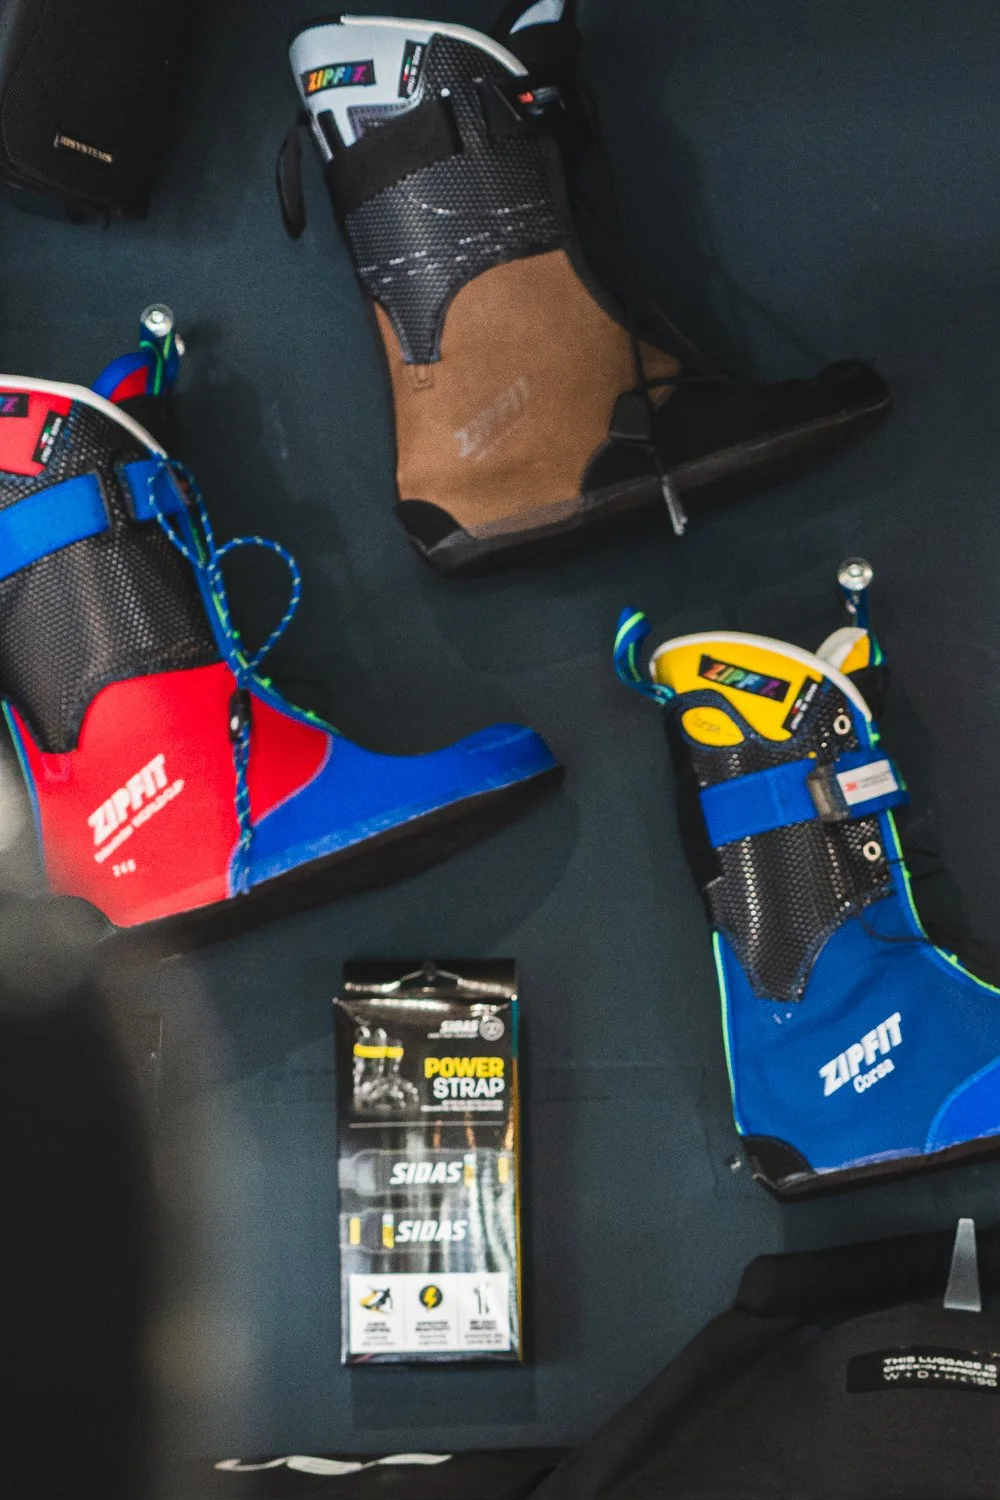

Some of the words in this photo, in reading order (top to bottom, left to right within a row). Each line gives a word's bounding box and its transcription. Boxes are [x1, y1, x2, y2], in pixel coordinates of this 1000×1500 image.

[87, 753, 168, 847] ZIPFIT
[819, 1012, 902, 1097] ZIPFIT
[424, 1056, 504, 1079] POWER
[853, 1058, 895, 1093] Corsa
[433, 1077, 505, 1099] STRAP
[389, 1161, 464, 1185] SIDAS
[395, 1220, 468, 1243] SIDAS
[883, 1356, 916, 1365] THIS
[918, 1356, 982, 1370] LUGGAGE
[984, 1363, 998, 1373] IS
[884, 1371, 901, 1381] W
[917, 1370, 930, 1379] D
